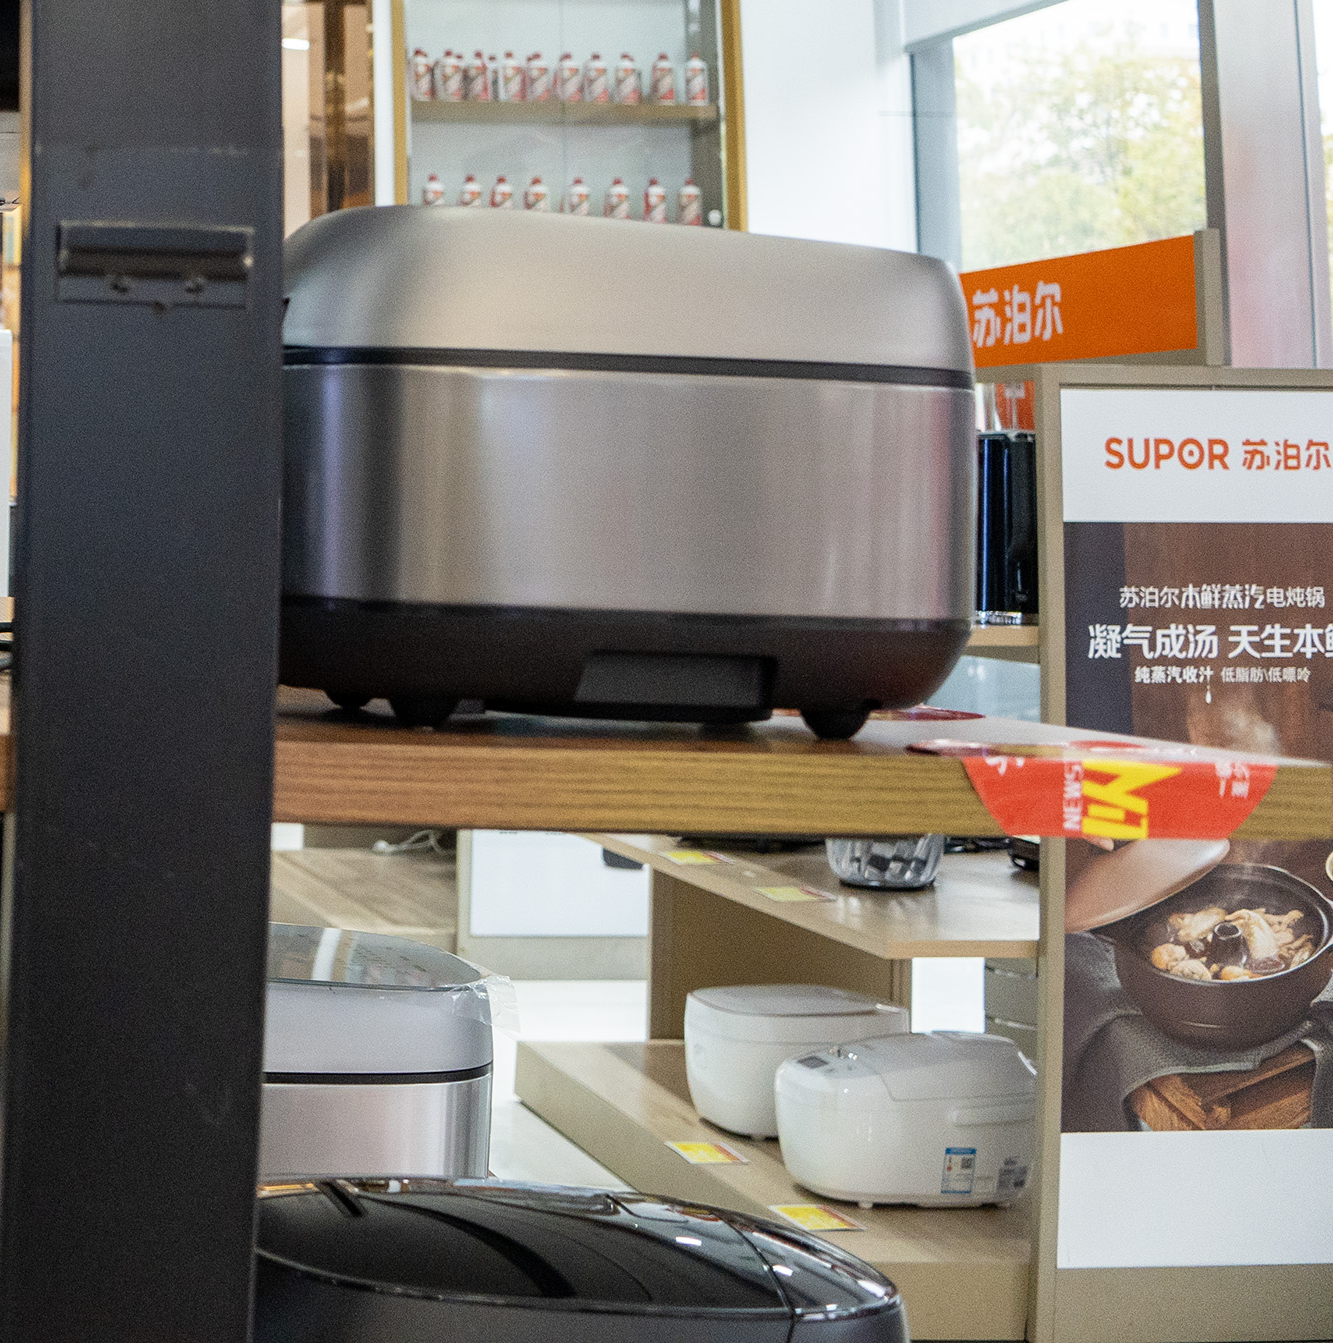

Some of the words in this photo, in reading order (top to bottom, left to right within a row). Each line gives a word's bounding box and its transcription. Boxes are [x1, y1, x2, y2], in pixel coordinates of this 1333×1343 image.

[972, 280, 1064, 349] 苏泊尔
[1105, 437, 1231, 471] SUPOR
[1242, 438, 1332, 471] 苏泊尔
[1120, 584, 1326, 609] 苏泊尔本鲜蒸汽电炖锅
[1087, 623, 1220, 660] 凝气成汤
[1228, 623, 1333, 659] 天生本
[1134, 665, 1214, 684] 纯蒸汽收汁
